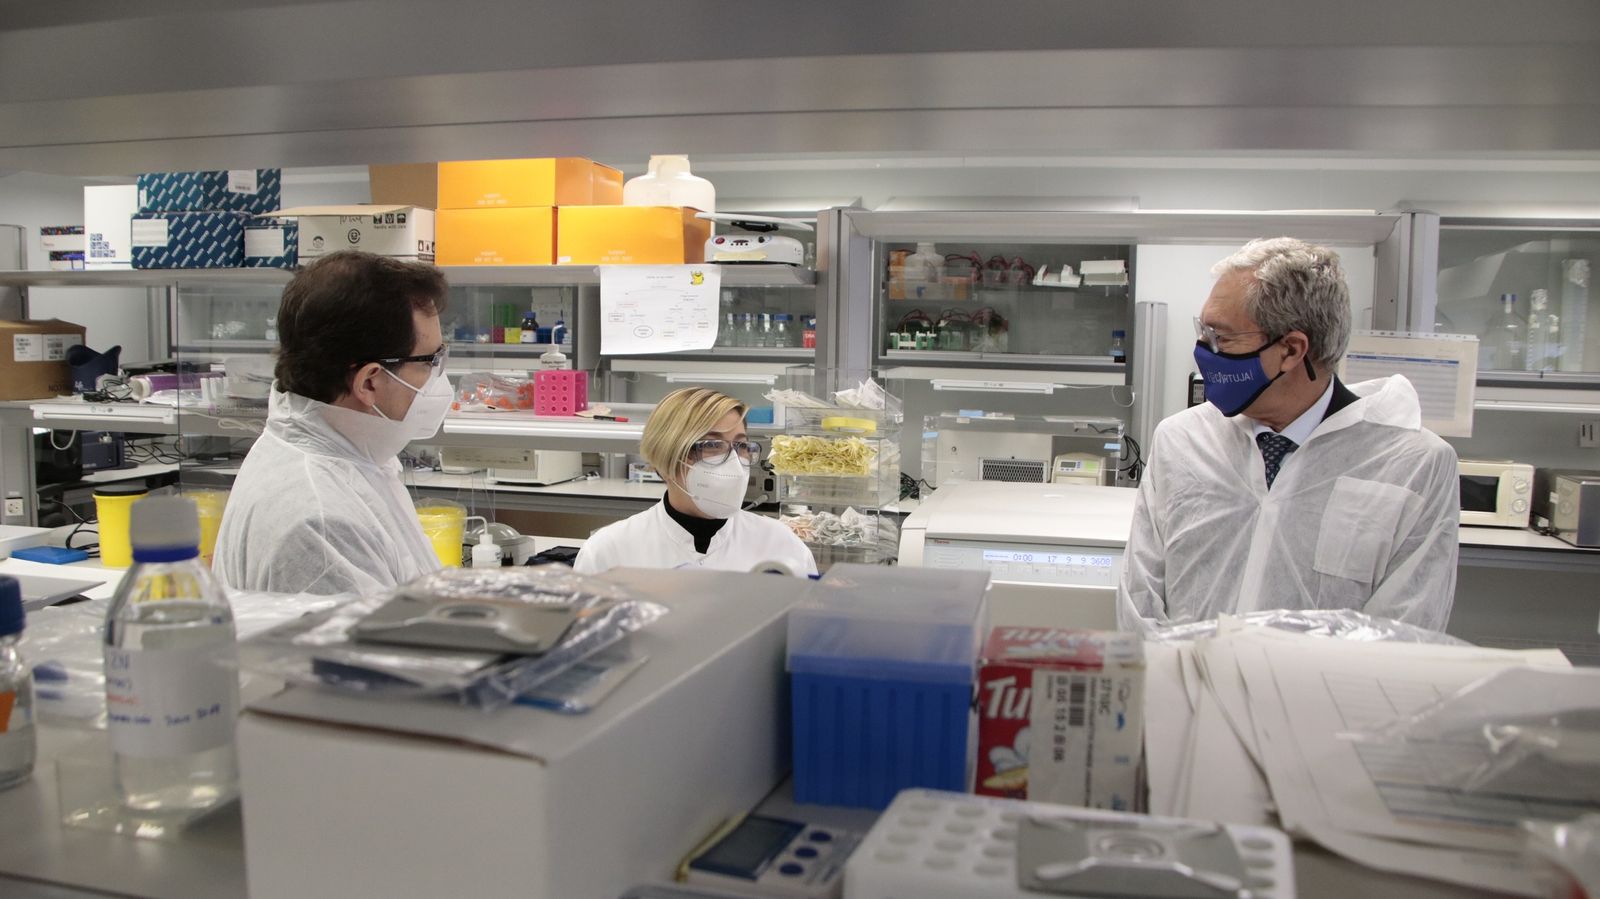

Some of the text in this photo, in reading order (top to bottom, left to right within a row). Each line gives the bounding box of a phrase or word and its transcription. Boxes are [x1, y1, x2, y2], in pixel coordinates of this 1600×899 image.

[1013, 553, 1033, 562] 0:00
[1047, 555, 1057, 563] 17
[985, 675, 1031, 720] Tu
